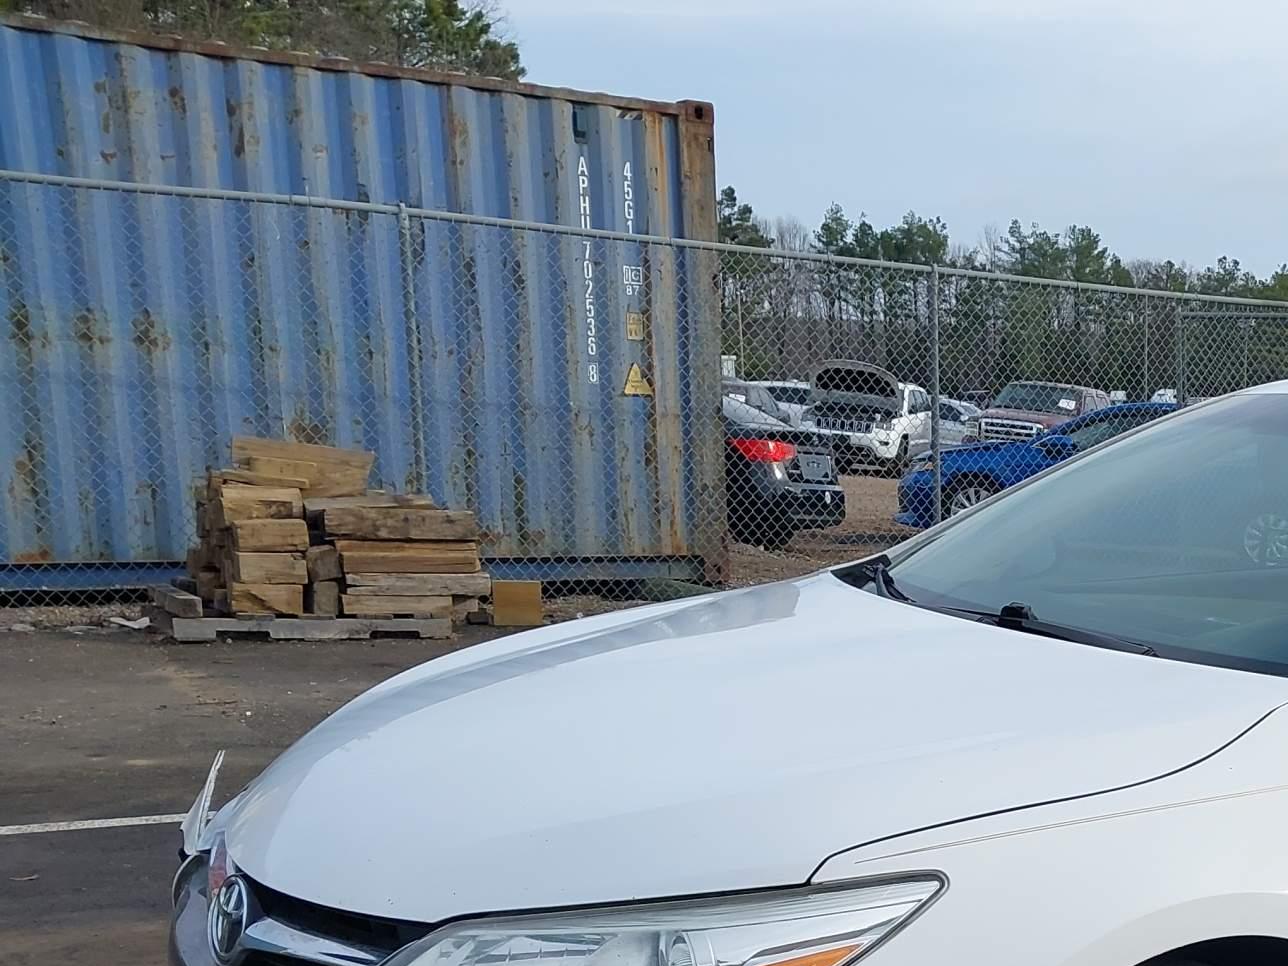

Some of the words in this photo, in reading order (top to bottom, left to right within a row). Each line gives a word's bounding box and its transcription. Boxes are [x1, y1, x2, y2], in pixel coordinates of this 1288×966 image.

[577, 155, 590, 230] APHU
[623, 161, 634, 235] 45G1
[582, 241, 597, 356] 702536
[626, 285, 640, 296] 87
[588, 364, 598, 383] 8
